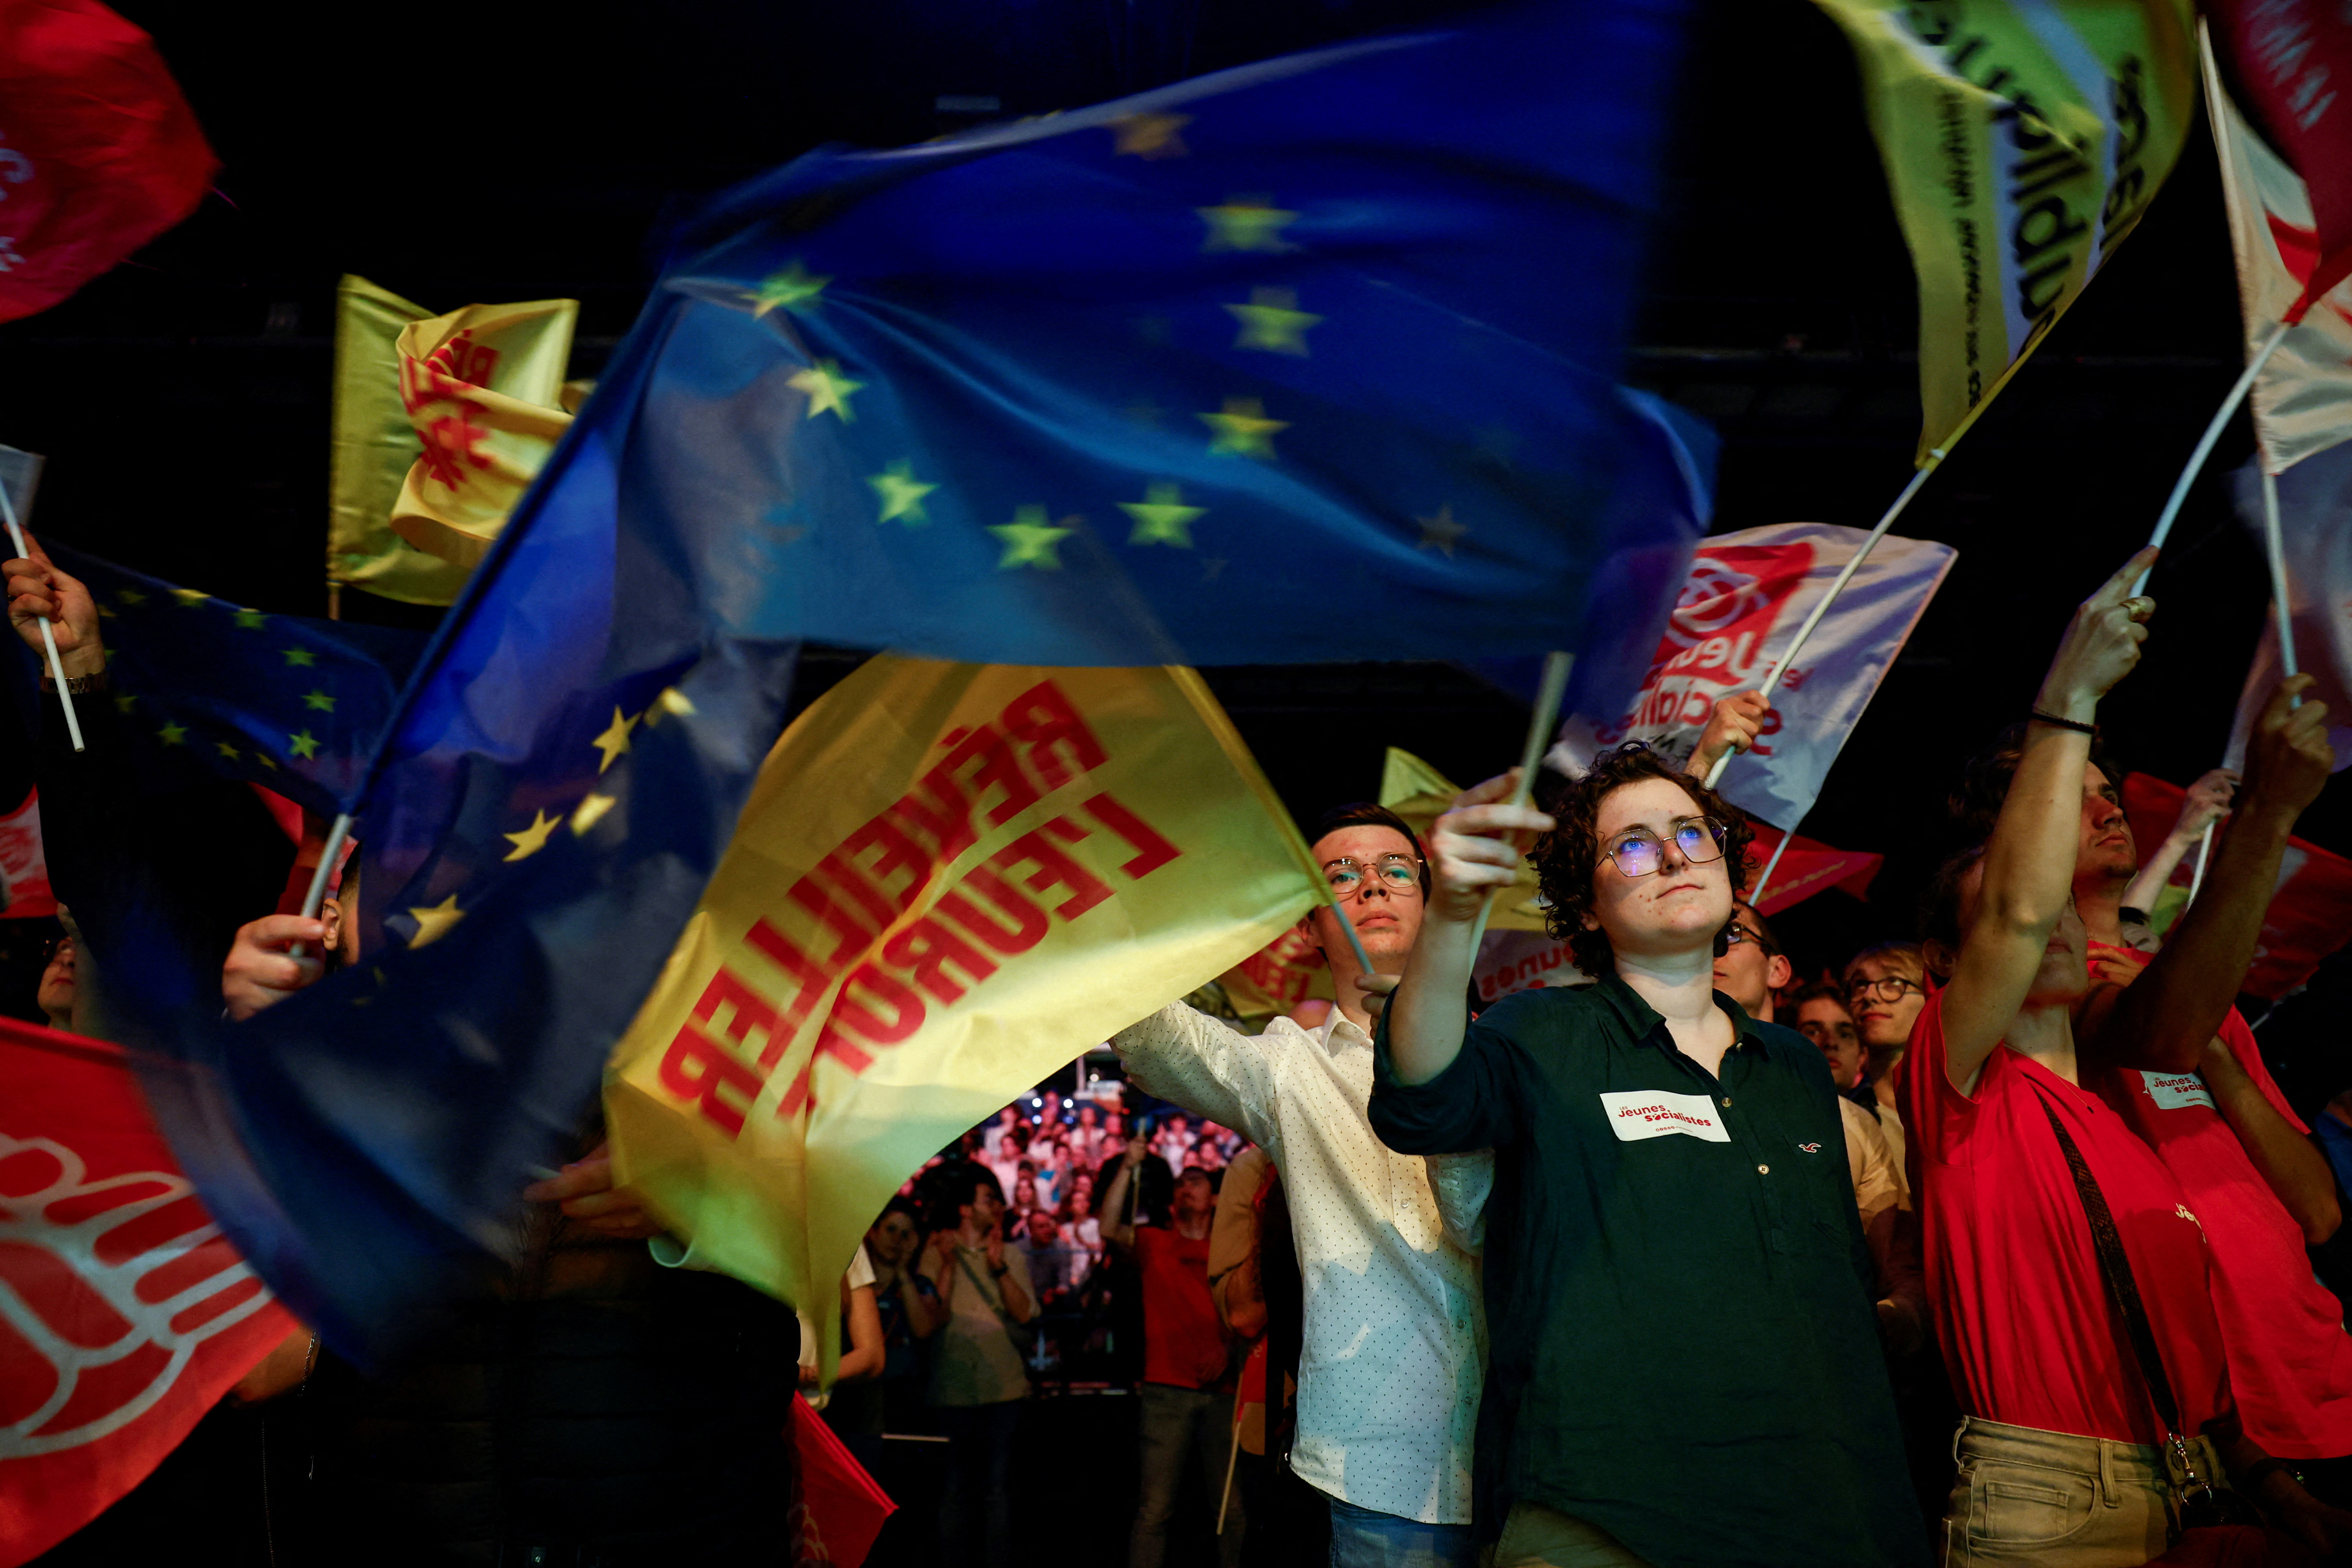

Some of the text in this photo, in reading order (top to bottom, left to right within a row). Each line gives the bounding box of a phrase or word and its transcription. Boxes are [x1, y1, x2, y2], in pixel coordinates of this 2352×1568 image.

[2154, 1077, 2191, 1087] Jeunes
[1618, 1105, 1666, 1117] Jeunes
[1644, 1110, 1711, 1127] socialistes
